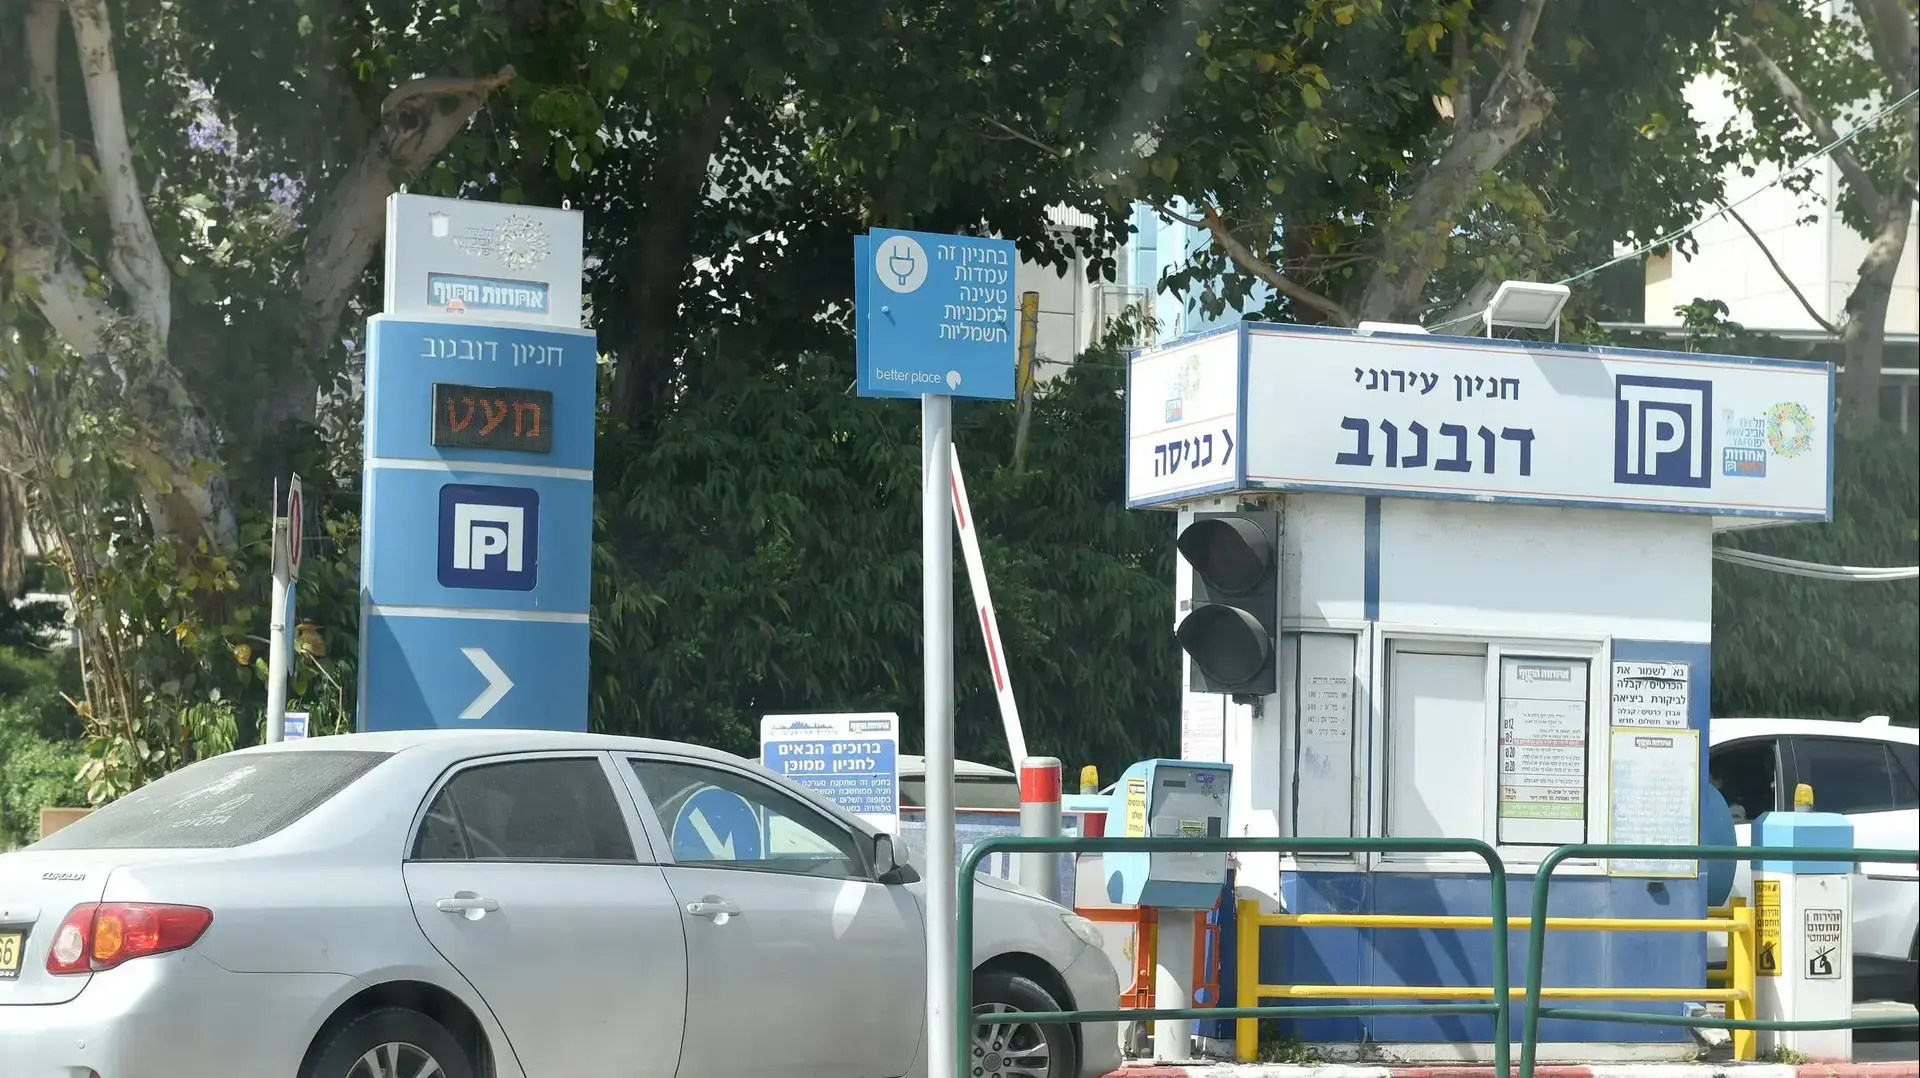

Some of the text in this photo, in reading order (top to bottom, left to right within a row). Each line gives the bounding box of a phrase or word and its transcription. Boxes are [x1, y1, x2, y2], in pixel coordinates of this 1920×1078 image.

[937, 244, 1008, 266] בחניון זה
[954, 266, 1008, 284] עמדות
[960, 286, 1008, 304] טעינה
[943, 304, 1007, 323] למכוניות
[939, 323, 1007, 343] חשמליות
[420, 337, 564, 367] חניון דובנוב
[876, 368, 941, 384] better place
[1354, 367, 1520, 402] חניון עירוני
[447, 397, 541, 437] מעט
[1335, 416, 1535, 476] דובנוב
[1154, 434, 1212, 478] כניסה
[1616, 666, 1684, 676] נא לשמור את
[1613, 694, 1686, 706] לביקורת ביציאה
[778, 743, 881, 755] ברוכים הבאים
[784, 757, 875, 773] לחניון ממוכן
[871, 779, 891, 788] בחניון
[840, 796, 863, 804] תשלום
[41, 872, 87, 881] COROLLA
[1813, 913, 1840, 921] זהירות
[1807, 923, 1840, 932] מחסום
[1807, 934, 1840, 942] אוטומטי
